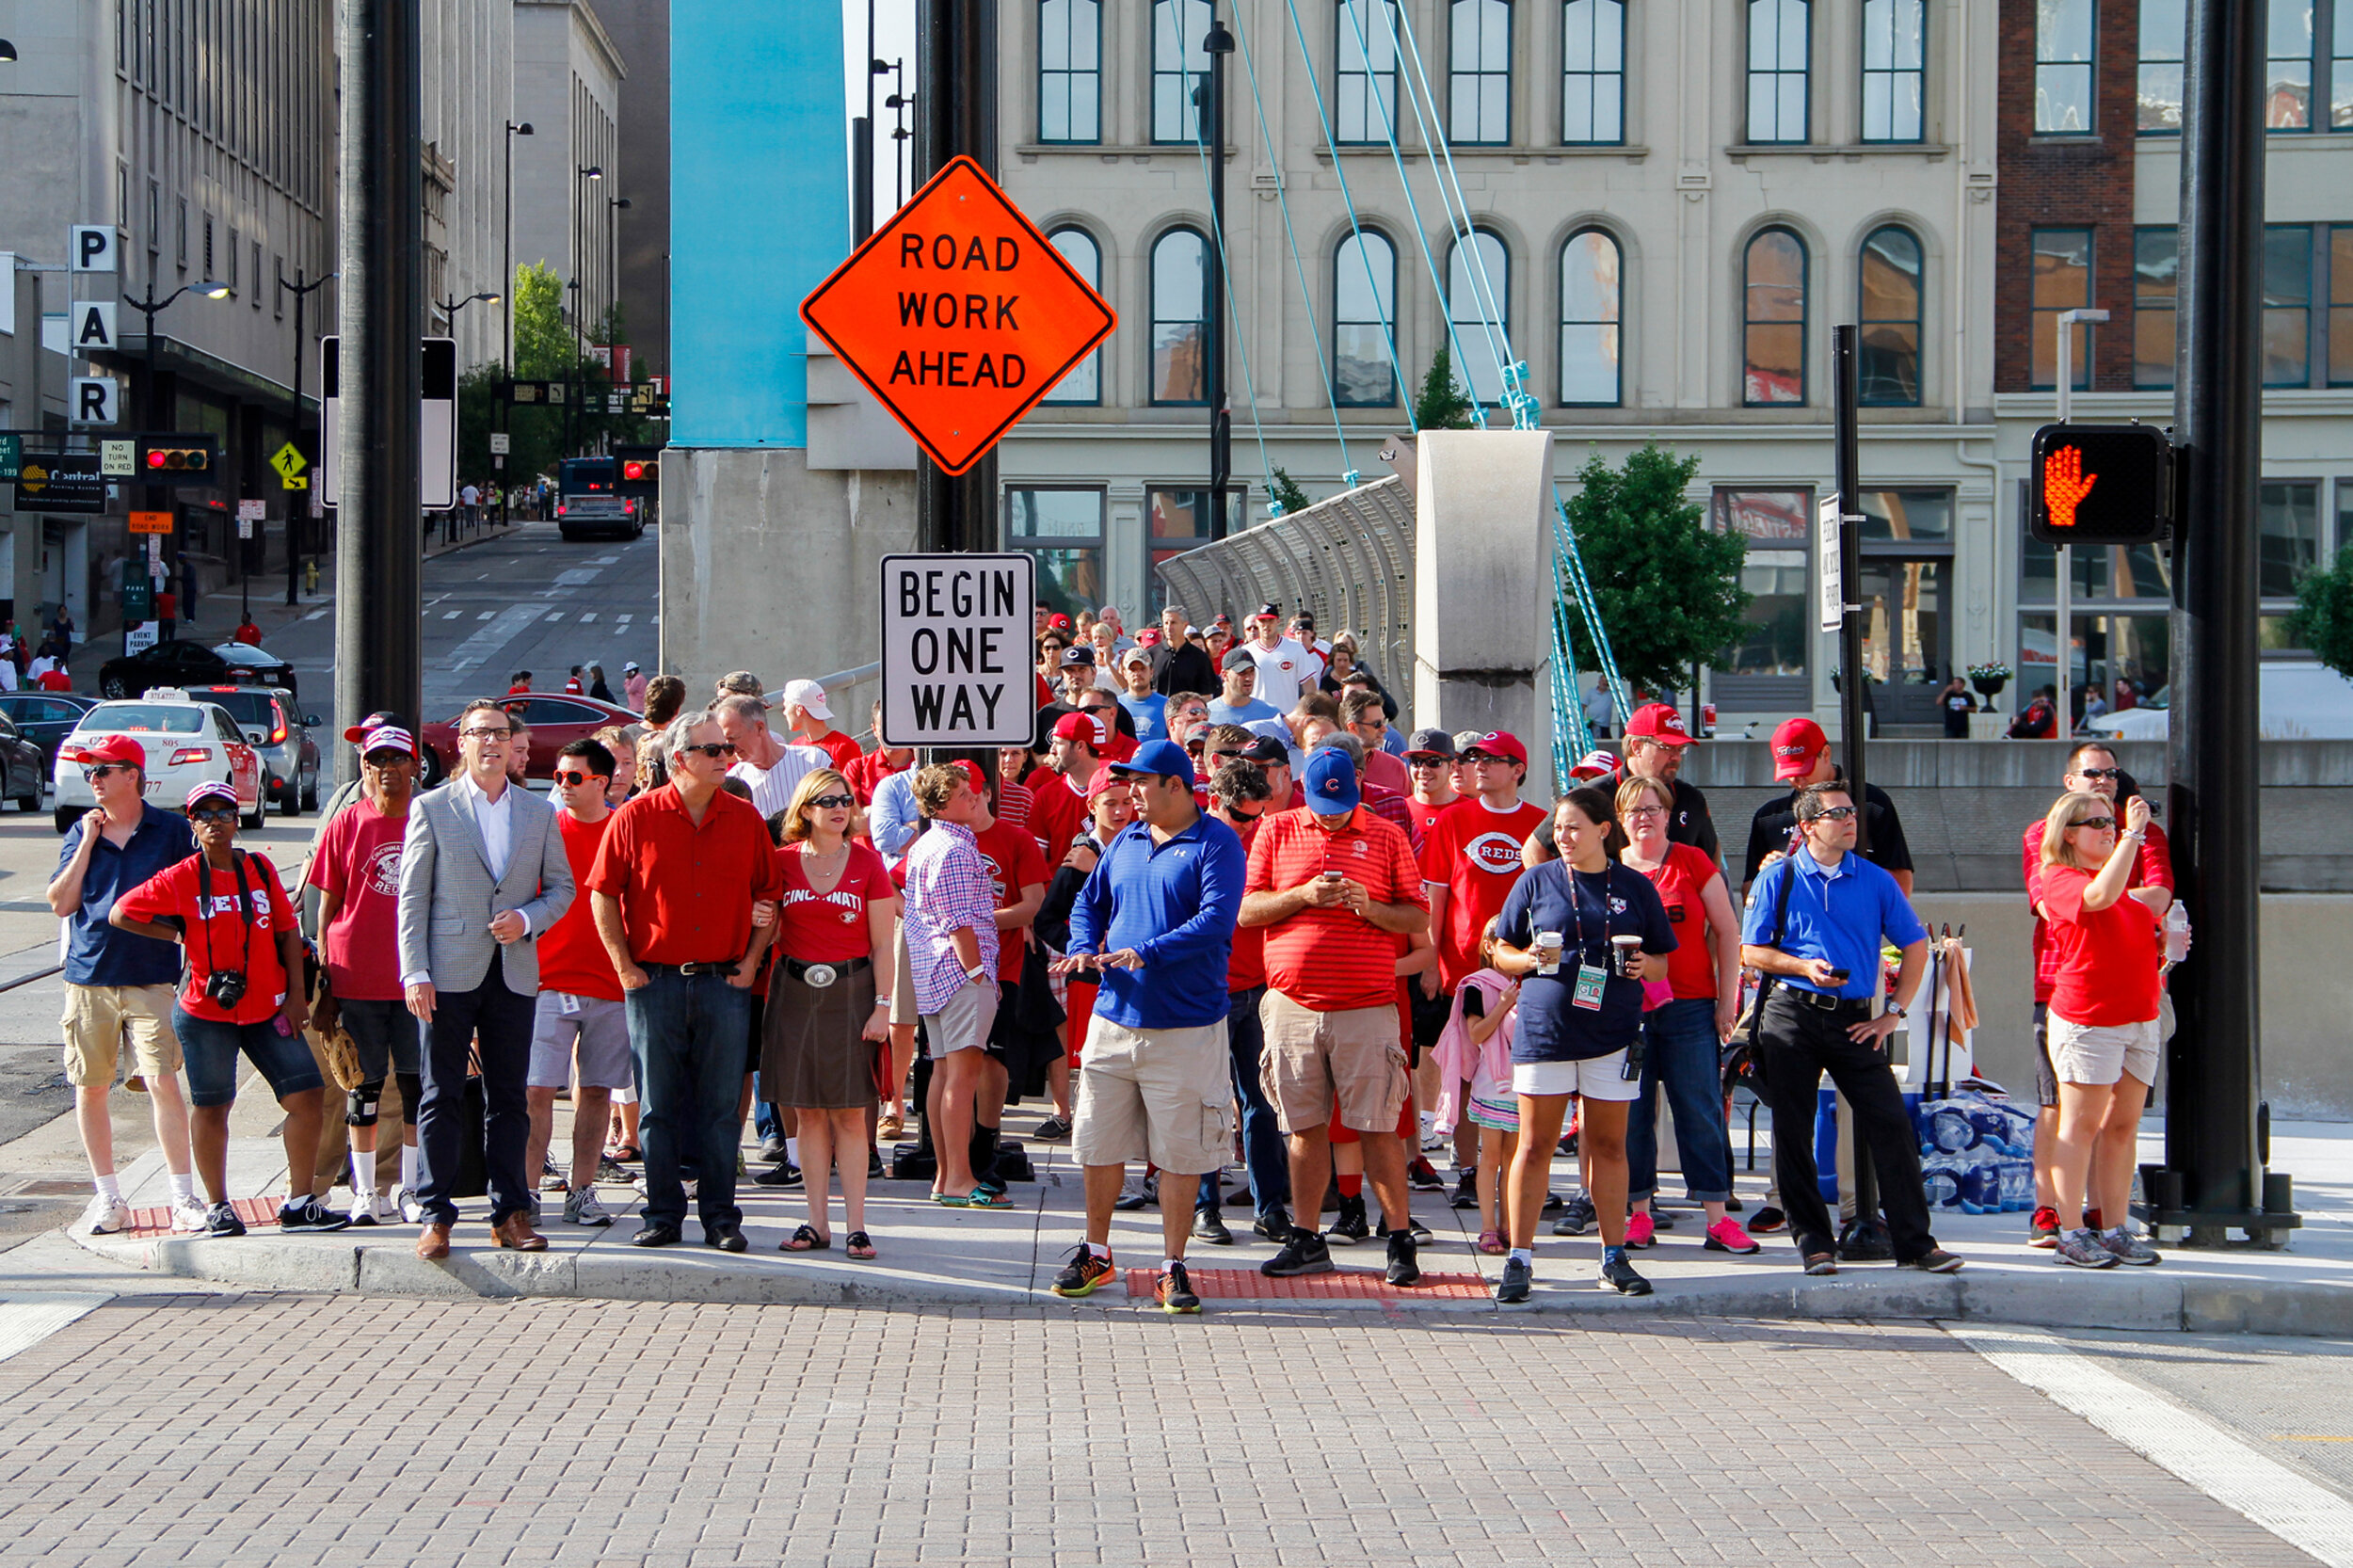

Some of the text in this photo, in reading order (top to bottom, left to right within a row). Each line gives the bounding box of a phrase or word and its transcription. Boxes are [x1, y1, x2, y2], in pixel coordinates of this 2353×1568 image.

[900, 232, 1020, 272] ROAD
[897, 291, 1020, 330] WORK
[888, 349, 1026, 389] AHEAD
[900, 569, 1015, 618] BEGIN
[911, 627, 1004, 676] ONE
[910, 683, 1005, 731] WAY
[162, 739, 180, 747] 805
[145, 780, 163, 793] 77
[1481, 846, 1522, 861] REDS
[375, 880, 400, 894] RED
